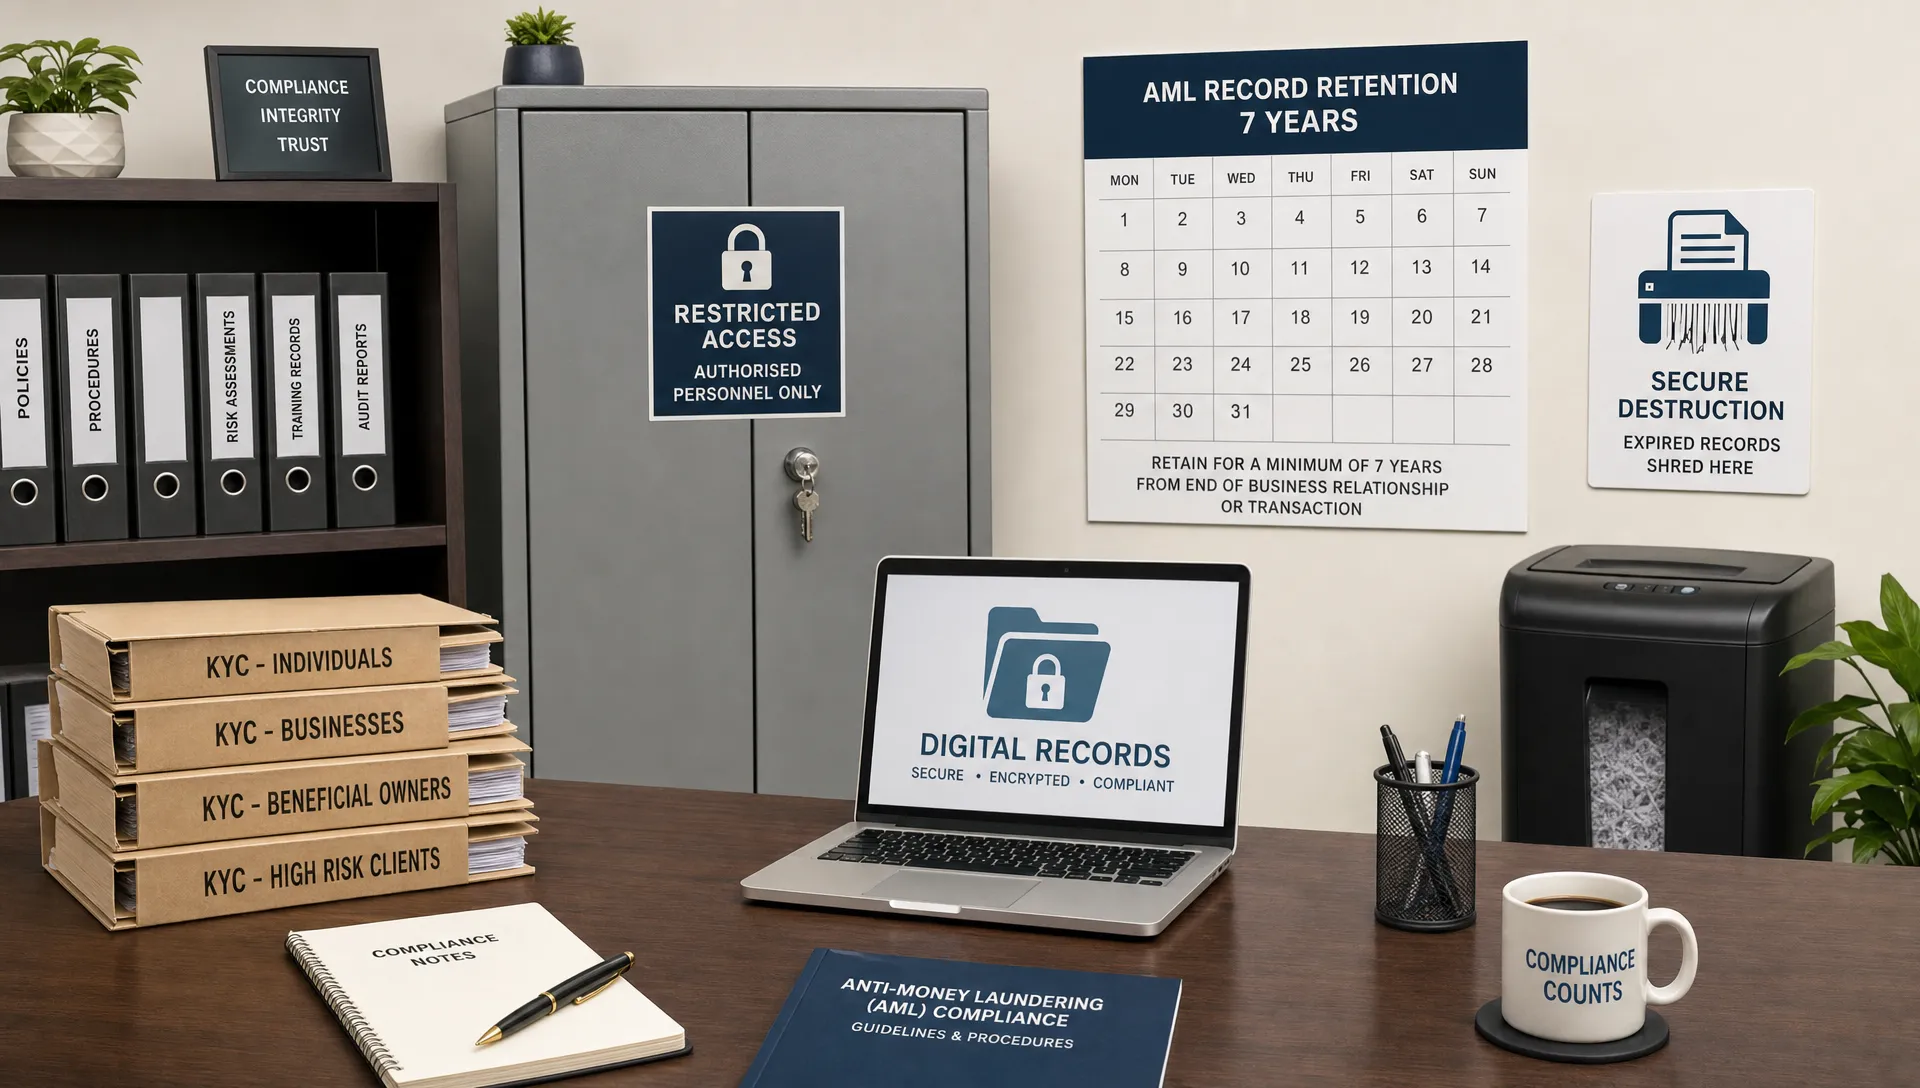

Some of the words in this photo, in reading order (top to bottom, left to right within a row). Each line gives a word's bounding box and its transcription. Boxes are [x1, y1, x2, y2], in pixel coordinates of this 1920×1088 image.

[246, 79, 348, 94] COMPLIANCE
[1143, 81, 1196, 102] AML
[1205, 78, 1307, 101] RECORD
[1318, 73, 1456, 97] RETENTION
[261, 108, 340, 122] INTEGRITY
[1239, 111, 1256, 134] 7
[1265, 109, 1357, 133] YEARS
[277, 137, 328, 151] TRUST
[1111, 175, 1138, 185] MON
[1171, 174, 1195, 185] TUE
[1228, 173, 1255, 183] WED
[1288, 172, 1313, 182] THU
[1352, 170, 1370, 181] FRI
[1410, 169, 1434, 180] SAT
[1470, 168, 1495, 179] SUN
[1120, 212, 1128, 227] 1
[1177, 211, 1188, 227] 2
[1236, 210, 1246, 226] 3
[1294, 209, 1305, 225] 4
[1355, 209, 1365, 224] 5
[1417, 208, 1427, 224] 6
[1477, 207, 1487, 223] 7
[1120, 261, 1130, 277] 8
[1177, 261, 1188, 277] 9
[1231, 260, 1250, 276] 10
[1291, 260, 1308, 276] 11
[1350, 259, 1370, 275] 12
[1412, 259, 1432, 275] 13
[1471, 258, 1491, 274] 14
[675, 303, 820, 323] RESTRICTED
[1115, 310, 1134, 325] 15
[1173, 310, 1192, 325] 16
[1232, 310, 1251, 325] 17
[1291, 309, 1311, 325] 18
[1350, 309, 1370, 325] 19
[1411, 308, 1433, 325] 20
[1471, 308, 1491, 325] 21
[289, 318, 301, 376] RECORDS
[702, 328, 796, 348] ACCESS
[223, 311, 237, 407] ASSESSMENTS
[356, 324, 368, 385] REPORTS
[1114, 356, 1135, 371] 22
[1172, 356, 1193, 372] 23
[1230, 356, 1252, 372] 24
[1290, 356, 1311, 372] 25
[1349, 356, 1371, 373] 26
[1411, 356, 1433, 373] 27
[1471, 357, 1493, 373] 28
[16, 338, 29, 418] POLICIES
[87, 329, 101, 431] PROCEDURES
[694, 363, 801, 378] AUTHORISED
[1652, 371, 1748, 391] SECURE
[674, 386, 773, 401] PERSONNEL
[779, 385, 821, 399] ONLY
[291, 382, 303, 440] TRAINING
[358, 390, 370, 430] AUDIT
[1114, 402, 1135, 418] 29
[1172, 403, 1194, 419] 30
[1231, 403, 1251, 419] 31
[1619, 399, 1783, 420] DESTRUCTION
[226, 412, 238, 442] RISK
[1625, 436, 1694, 450] EXPIRED
[1701, 437, 1780, 452] RECORDS
[1153, 456, 1206, 469] RETAIN
[1214, 457, 1244, 470] FOR
[1250, 458, 1260, 470] A
[1267, 458, 1341, 471] MINIMUM
[1349, 459, 1369, 472] OF
[1374, 459, 1384, 473] 7
[1390, 460, 1441, 473] YEARS
[1648, 459, 1703, 473] SHRED
[1710, 460, 1753, 474] HERE
[1138, 478, 1180, 490] FROM
[1187, 479, 1217, 491] END
[1223, 479, 1243, 492] OF
[1249, 479, 1327, 493] BUSINESS
[1334, 481, 1448, 495] RELATIONSHIP
[1222, 500, 1242, 513] OR
[1248, 500, 1361, 515] TRANSACTION
[207, 654, 249, 678] KYC
[274, 647, 392, 674] INDIVIDUALS
[216, 720, 256, 746] KYC
[282, 711, 403, 741] BUSINESSES
[921, 733, 1025, 760] DIGITAL
[1036, 739, 1170, 768] RECORDS
[912, 767, 963, 781] SECURE
[990, 771, 1069, 786] ENCRYPTED
[1094, 777, 1174, 792] COMPLIANT
[203, 793, 244, 821] KYC
[268, 784, 373, 815] BENEFICIAL
[380, 777, 450, 805] OWNERS
[205, 868, 245, 896] KYC
[271, 861, 316, 889] HIGH
[324, 855, 364, 882] RISK
[371, 847, 440, 877] CLIENTS
[372, 934, 498, 959] COMPLIANCE
[411, 952, 476, 966] NOTES
[1526, 949, 1635, 975] COMPLIANCE
[841, 979, 970, 1001] ANTI-MONEY
[975, 991, 1103, 1010] LAUNDERING
[1544, 980, 1622, 1004] COUNTS
[868, 998, 926, 1018] (AML)
[934, 1006, 1069, 1027] COMPLIANCE
[852, 1022, 946, 1039] GUIDELINES
[952, 1031, 961, 1040] &
[968, 1032, 1073, 1048] PROCEDURES
